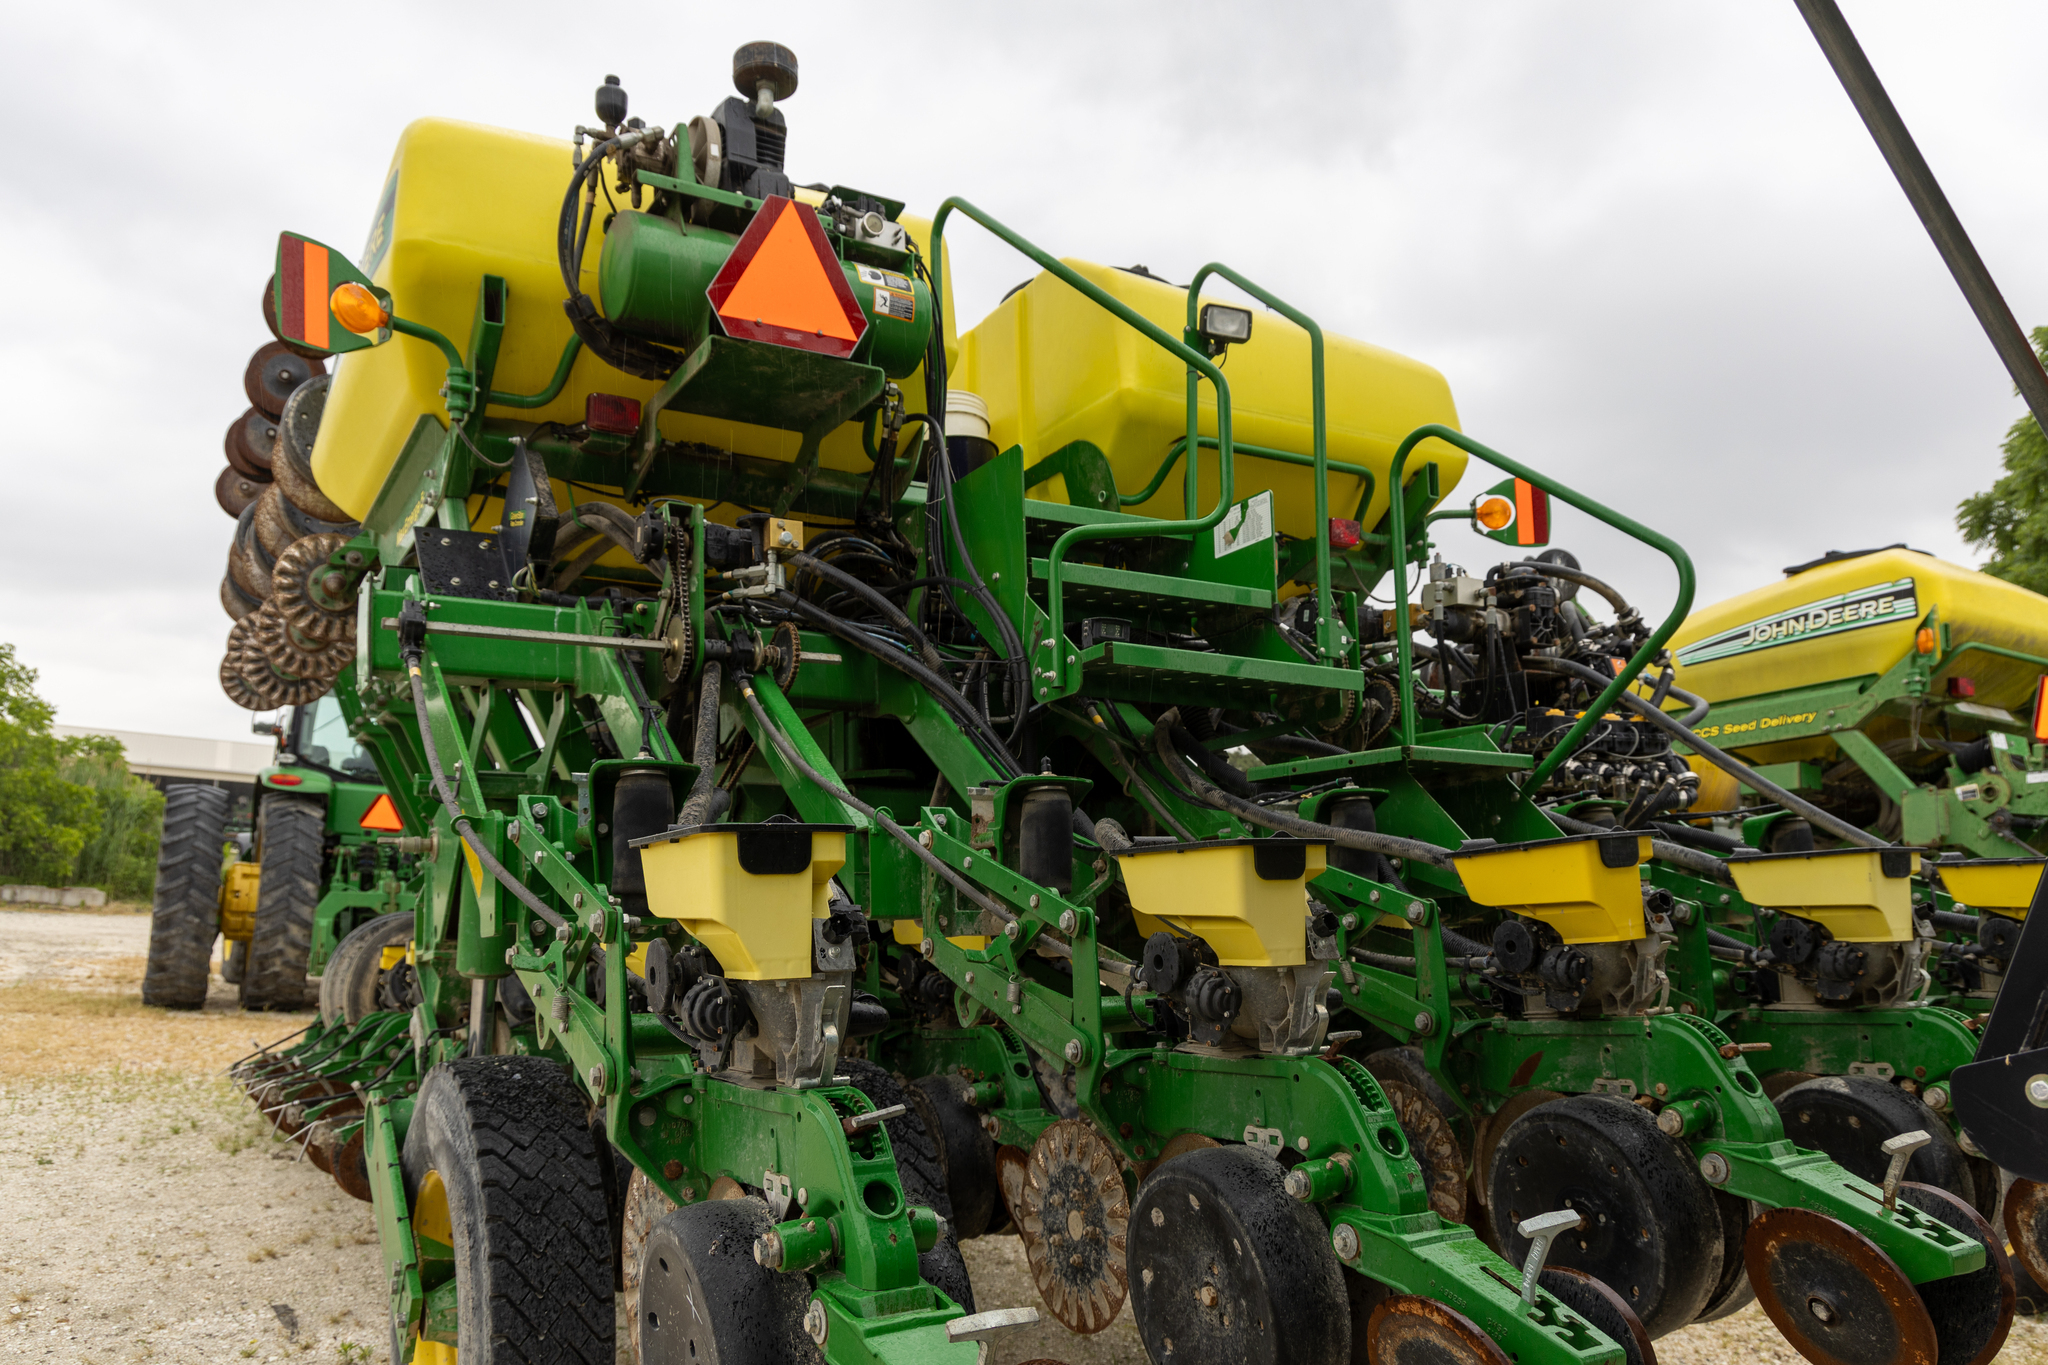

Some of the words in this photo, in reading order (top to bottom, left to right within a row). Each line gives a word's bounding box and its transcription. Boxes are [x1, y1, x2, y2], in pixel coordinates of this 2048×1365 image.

[1742, 616, 1805, 647] JOHN
[1809, 596, 1895, 631] DEERE
[1723, 720, 1757, 735] Seed
[1760, 711, 1817, 729] Delivery
